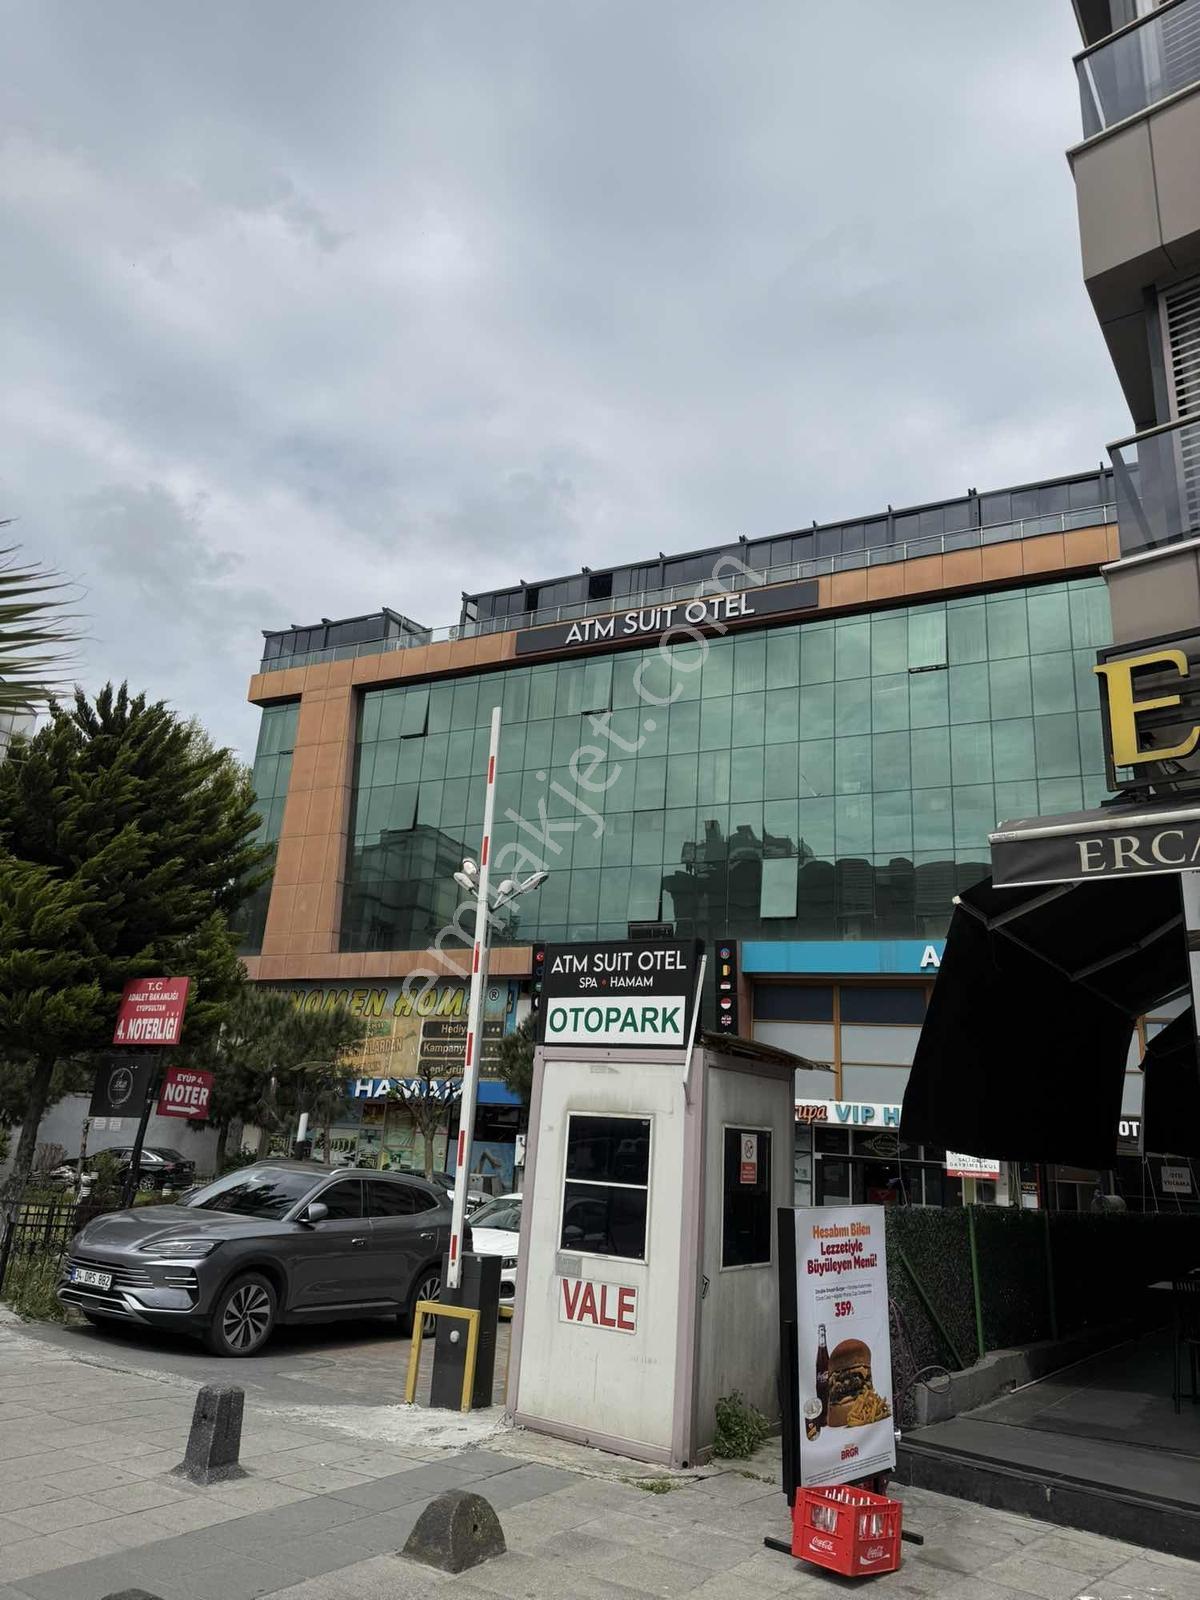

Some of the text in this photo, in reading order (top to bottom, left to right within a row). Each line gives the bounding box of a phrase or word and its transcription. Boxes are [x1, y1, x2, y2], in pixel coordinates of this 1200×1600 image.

[565, 619, 615, 645] ATM
[685, 593, 755, 624] OTEL
[551, 954, 588, 974] ATM
[637, 950, 687, 971] OTEL
[579, 976, 654, 988] SPA HAMAM
[393, 986, 471, 1018] HOM
[117, 1019, 125, 1040] 4.
[441, 1024, 467, 1034] Hediy
[549, 1007, 681, 1034] OTOPARK
[423, 1042, 467, 1054] Kampany
[177, 1073, 197, 1082] EYÜP
[164, 1082, 209, 1105] NOTER
[835, 1104, 875, 1124] VIP
[1118, 1120, 1140, 1137] OT
[850, 1222, 871, 1237] Bilen
[820, 1238, 863, 1256] Lezzetiyle
[807, 1257, 852, 1276] Büyüleyen
[562, 1278, 636, 1330] VALE
